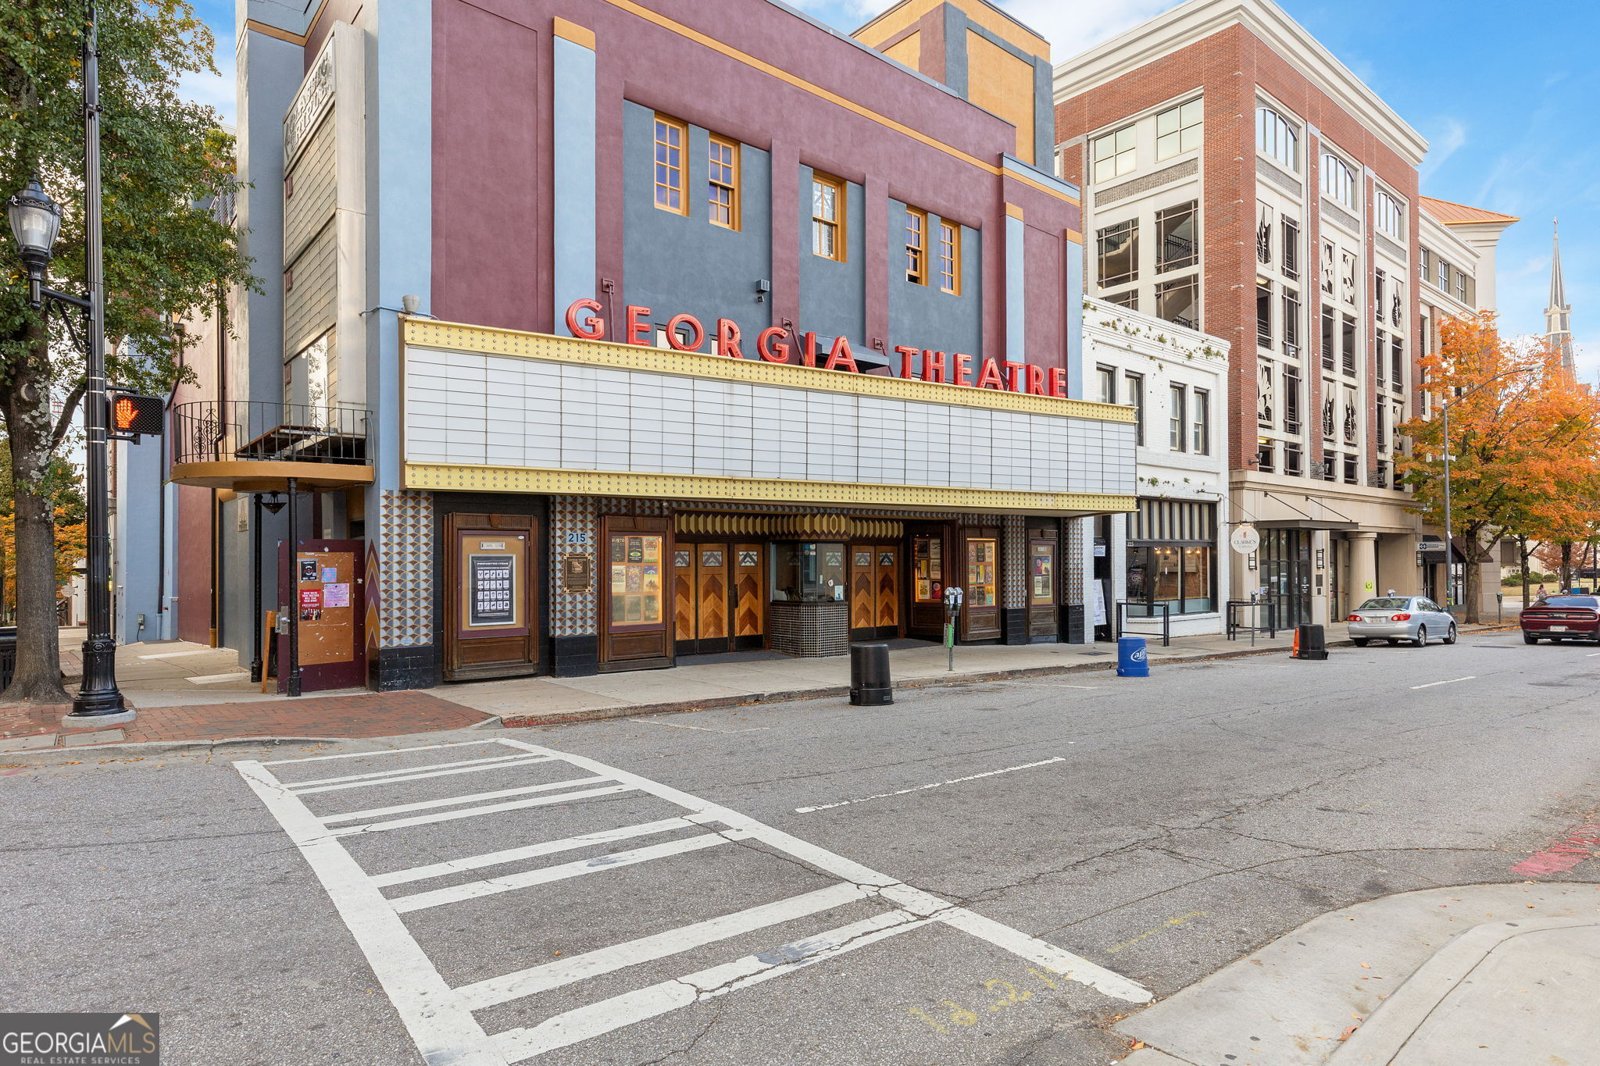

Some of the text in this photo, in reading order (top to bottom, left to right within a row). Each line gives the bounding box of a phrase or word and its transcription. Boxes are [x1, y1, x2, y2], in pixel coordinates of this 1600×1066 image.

[565, 298, 1068, 398] GEORGIA THEATRE
[569, 533, 586, 543] 215
